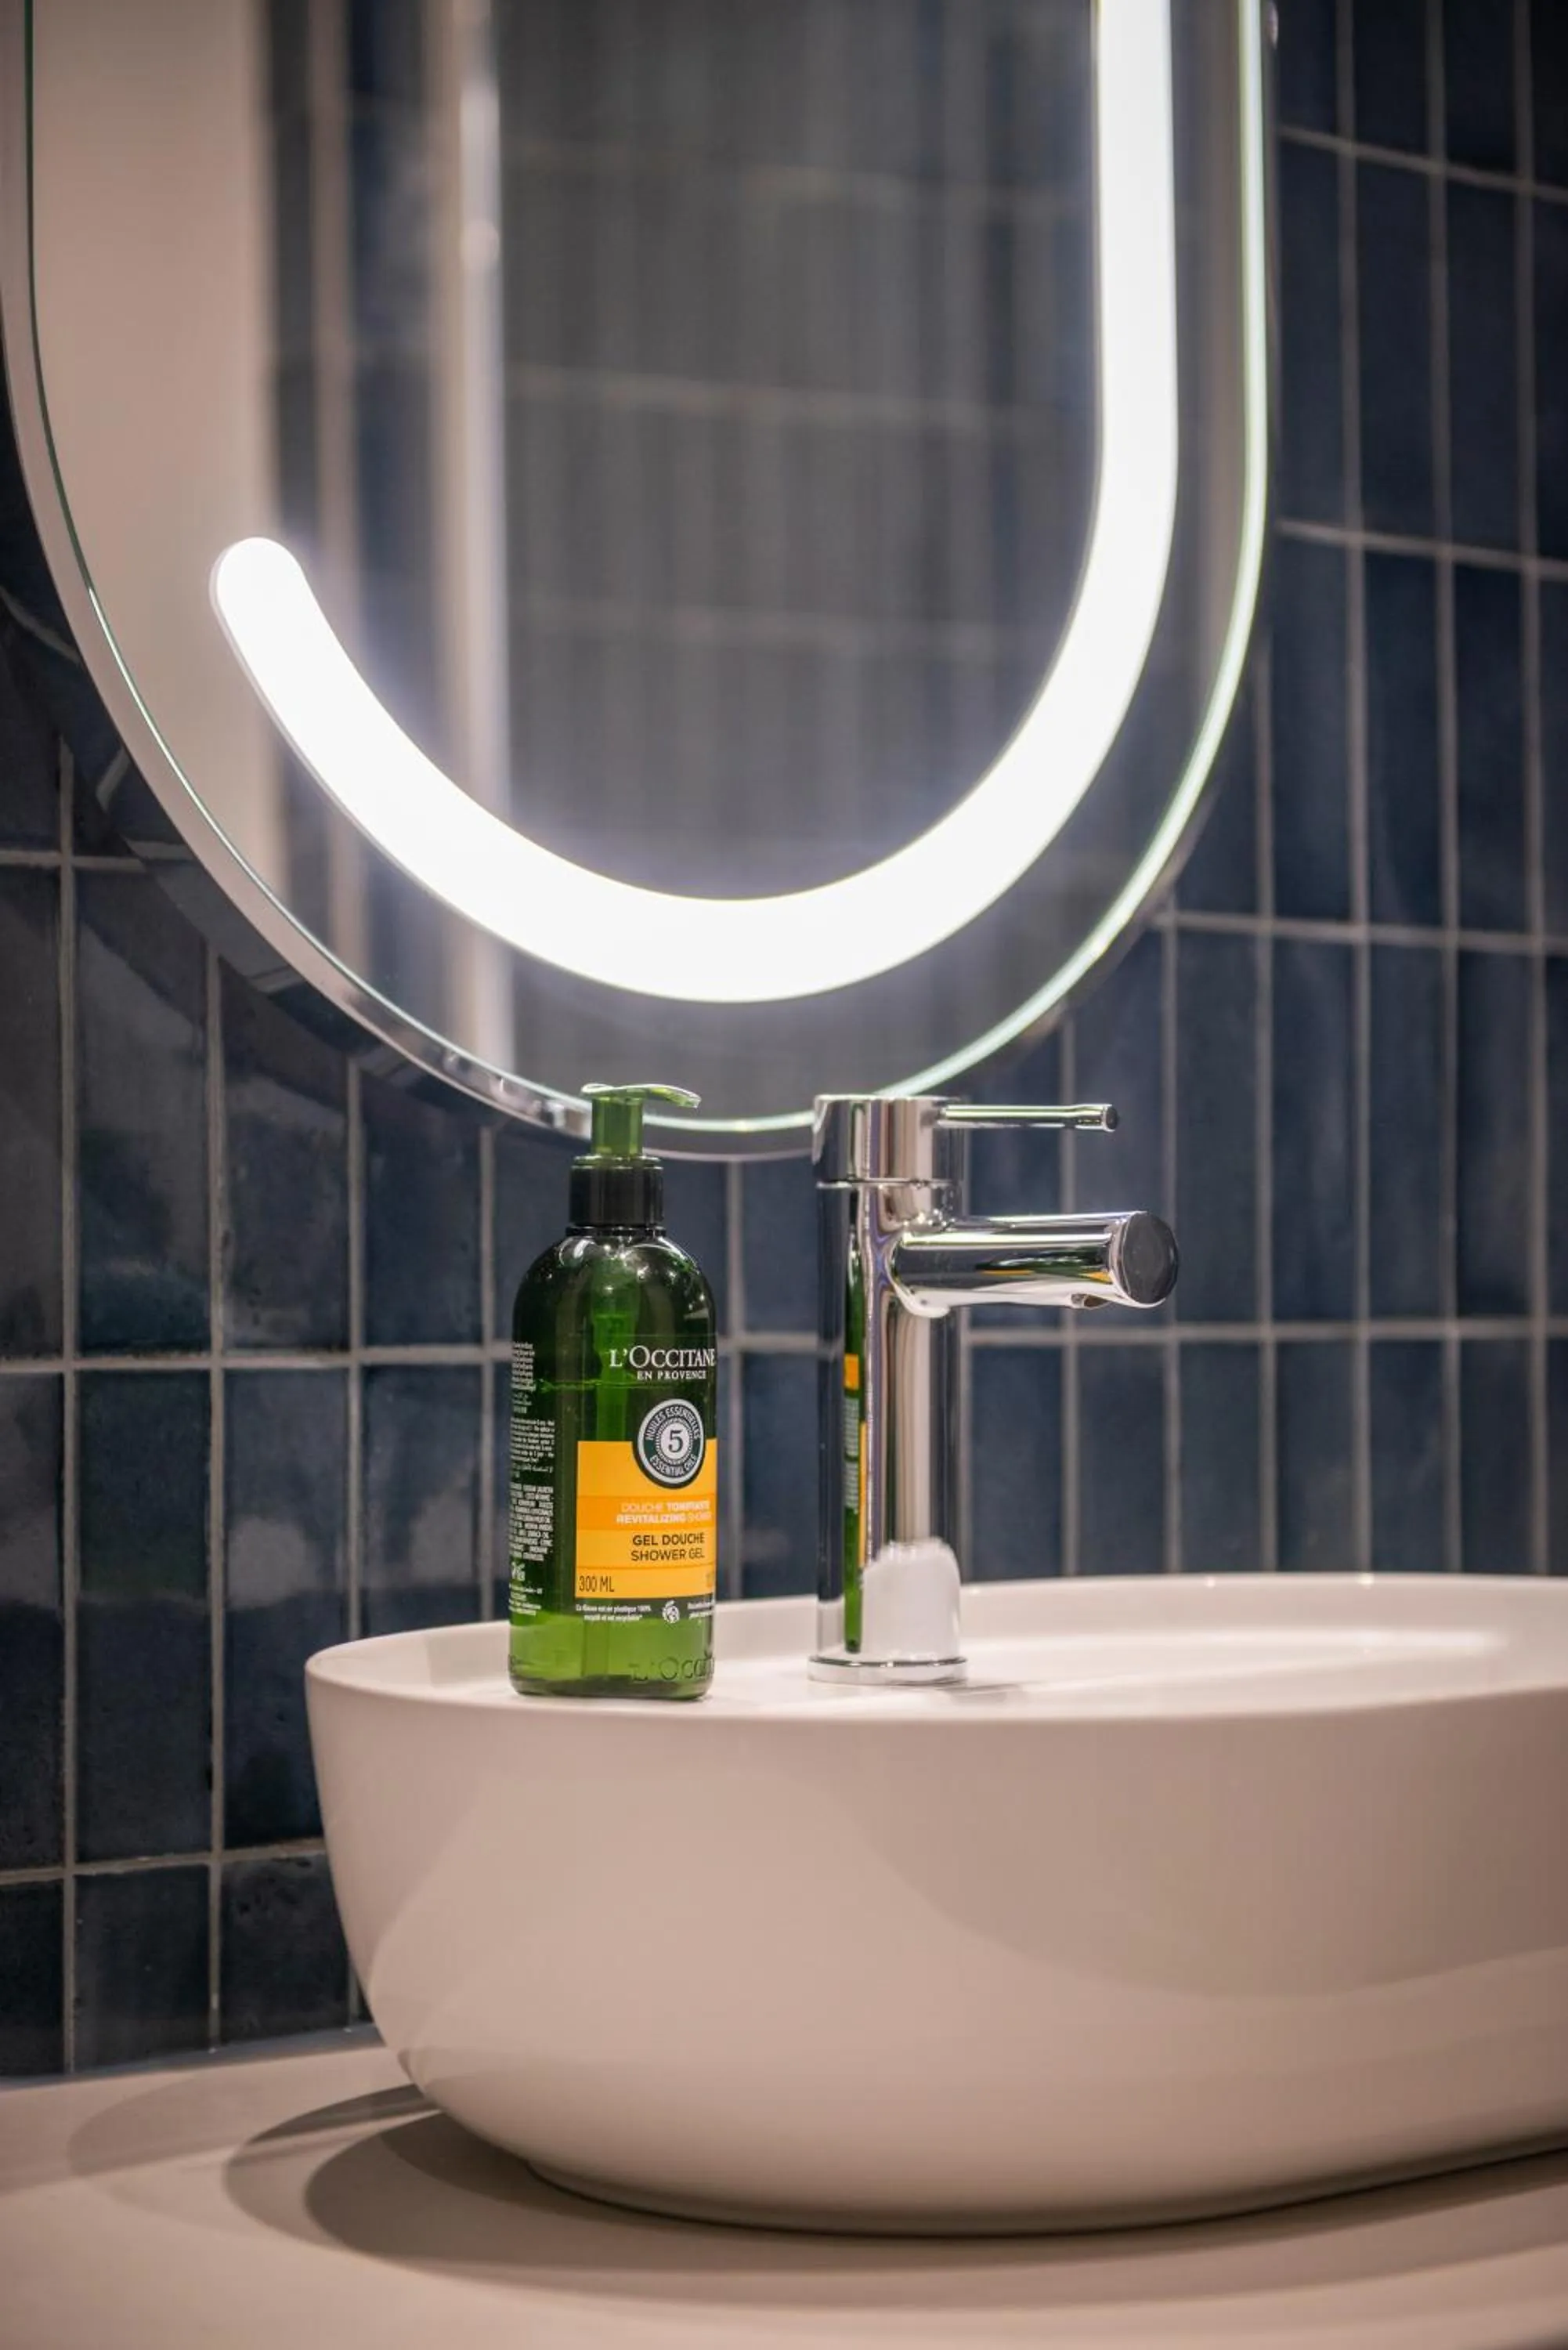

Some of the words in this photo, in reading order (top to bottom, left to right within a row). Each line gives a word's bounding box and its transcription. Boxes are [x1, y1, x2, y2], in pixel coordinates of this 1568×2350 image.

[609, 1344, 717, 1368] L'OCCITANE
[636, 1370, 653, 1381] EN
[656, 1369, 707, 1380] PROVENCE
[668, 1429, 684, 1453] 5
[632, 1535, 659, 1546] GEL
[662, 1533, 705, 1546] DOUCHE
[630, 1549, 687, 1562] SHOWER
[688, 1547, 704, 1560] GEL
[578, 1575, 596, 1593] 300
[599, 1575, 615, 1593] ML
